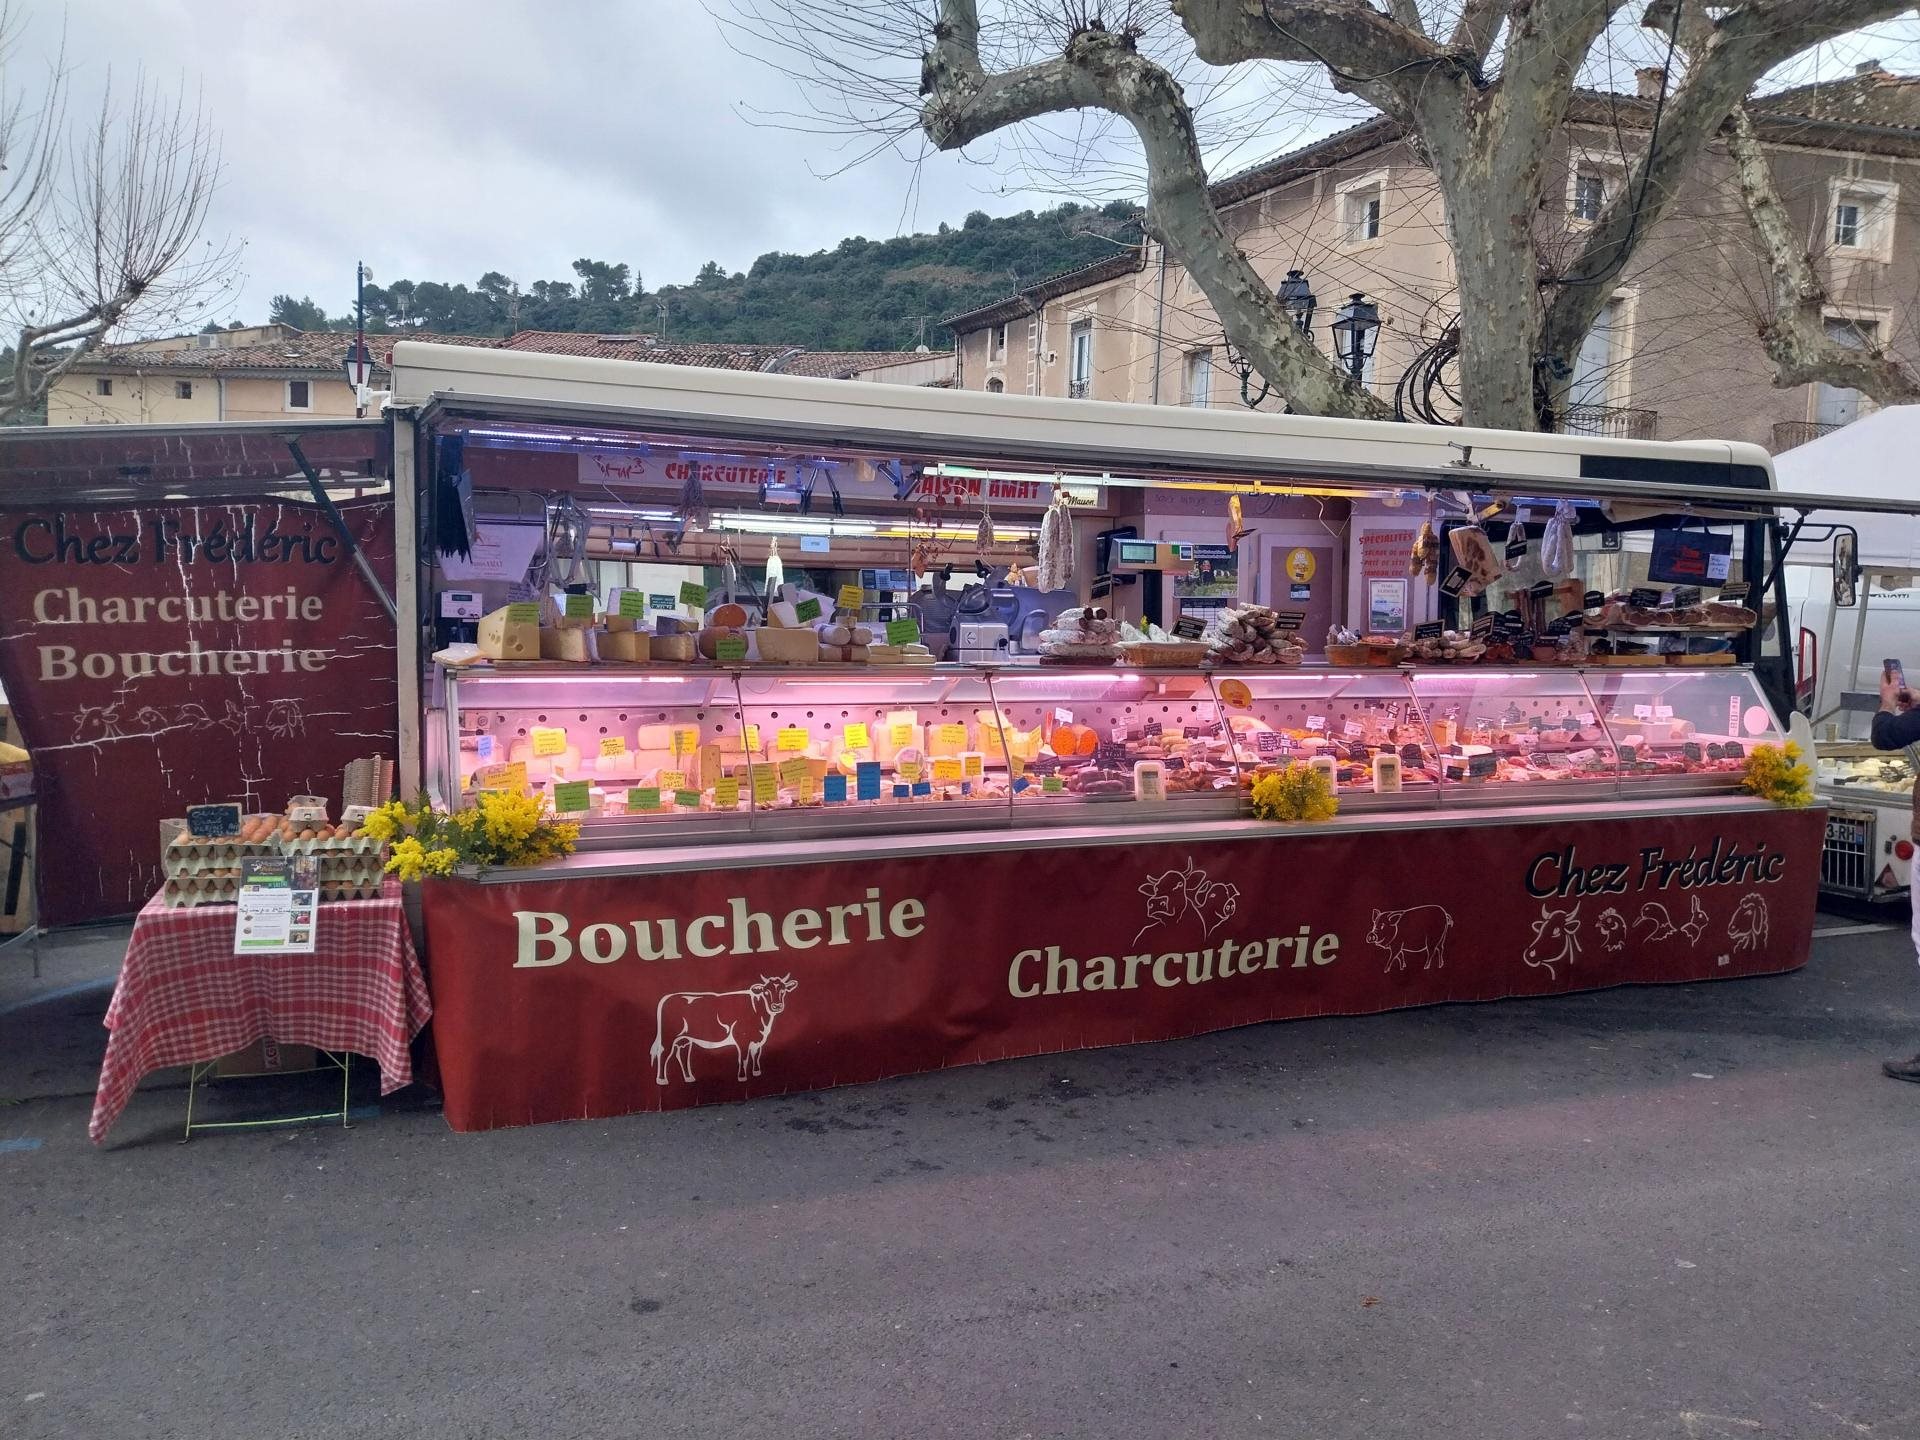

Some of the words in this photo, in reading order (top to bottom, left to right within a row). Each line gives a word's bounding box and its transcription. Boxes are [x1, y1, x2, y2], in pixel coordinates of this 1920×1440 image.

[665, 462, 786, 484] CHRCUTERE
[914, 475, 981, 496] AISON
[989, 479, 1040, 499] AMAT
[14, 512, 139, 564] Chez
[148, 512, 337, 564] Frédéric
[33, 586, 324, 625] Charcuterie
[38, 638, 328, 682] Boucherie
[1525, 845, 1629, 900] Chez
[1637, 836, 1786, 892] Frédéric
[512, 887, 927, 969] Boucherie
[1008, 925, 1340, 999] Charcuterie
